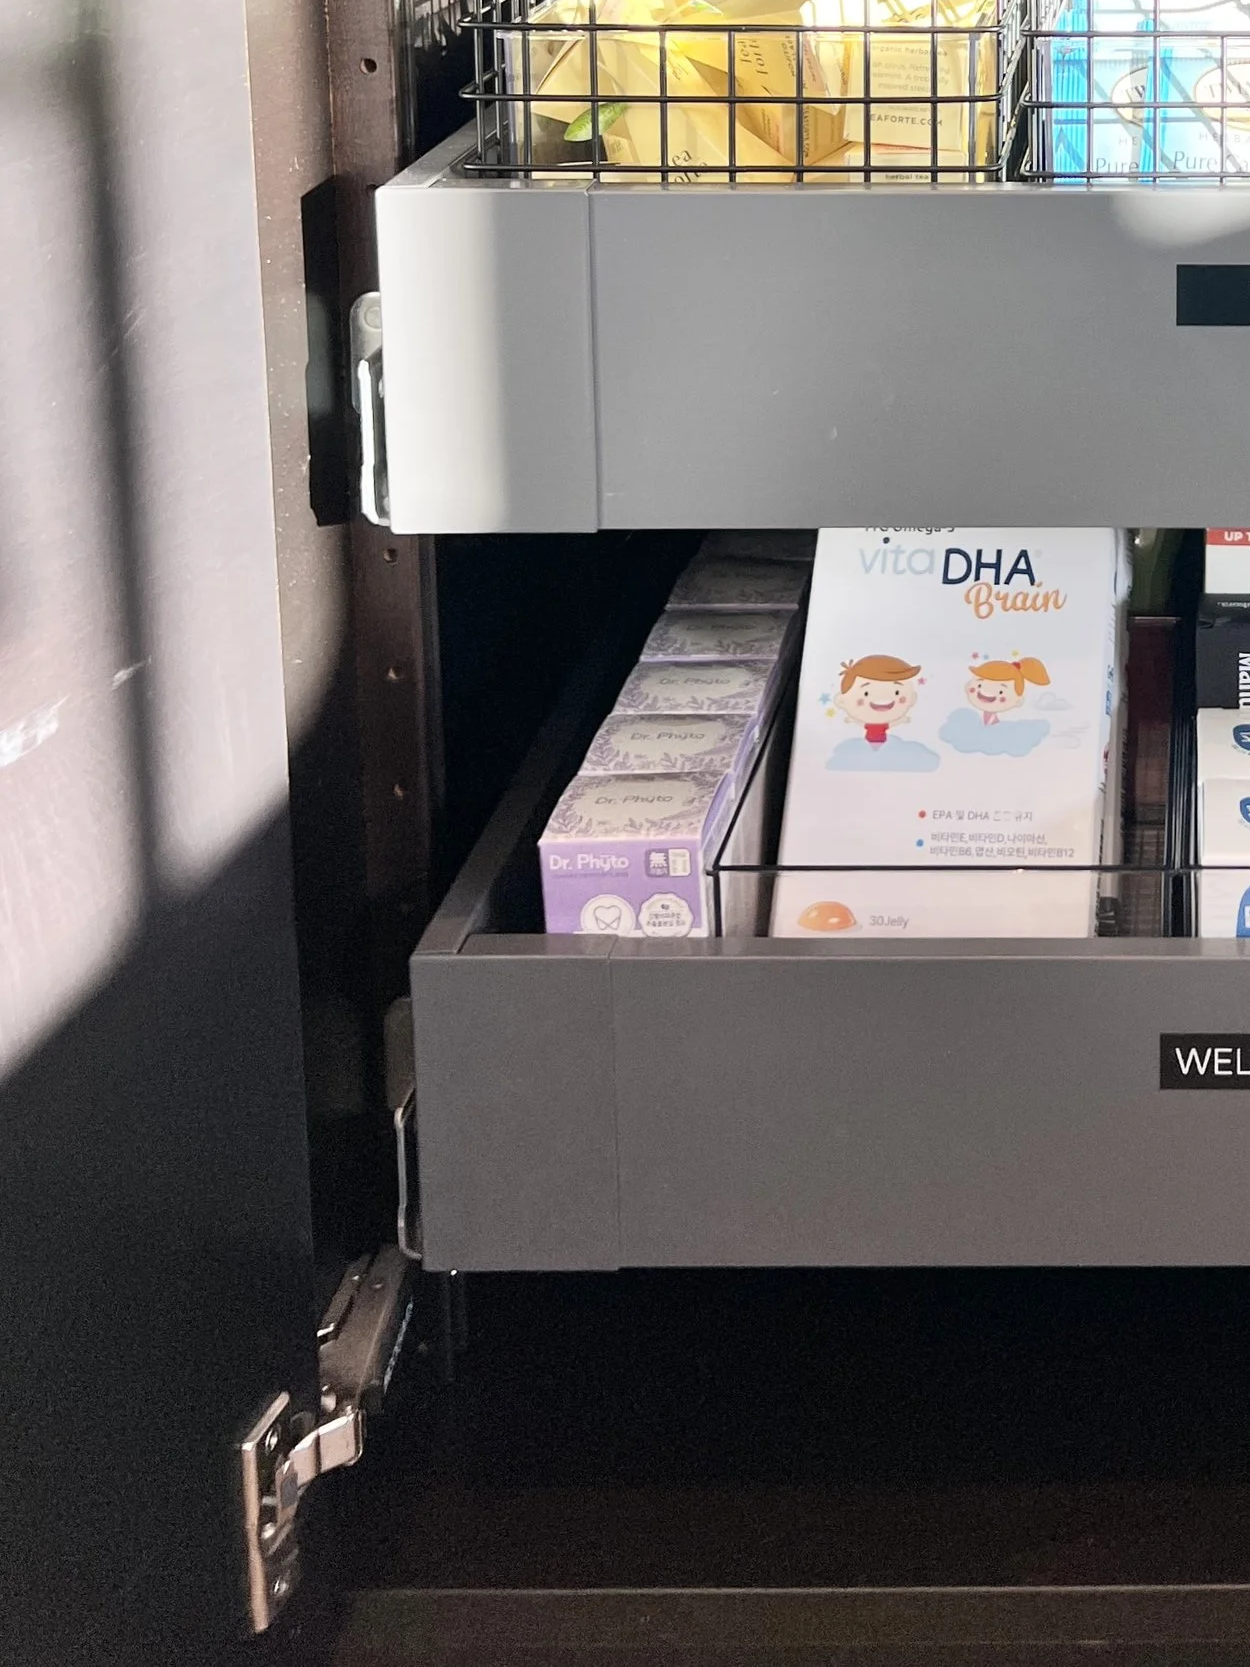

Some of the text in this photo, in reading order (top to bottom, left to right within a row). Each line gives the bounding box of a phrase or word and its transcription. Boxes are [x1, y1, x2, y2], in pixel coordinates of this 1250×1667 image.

[904, 46, 933, 56] herba
[869, 113, 943, 127] EAFORTE.COM
[1224, 531, 1245, 542] UP
[858, 536, 1037, 587] vita DHA
[963, 581, 1068, 620] Brain
[630, 732, 706, 742] Dr. Phyto
[594, 794, 674, 806] Dr. Phyto
[932, 809, 953, 820] EPA
[967, 809, 990, 821] DHA
[549, 854, 574, 871] Dr.
[577, 853, 630, 872] Phyto
[869, 915, 910, 929] 30Jelly
